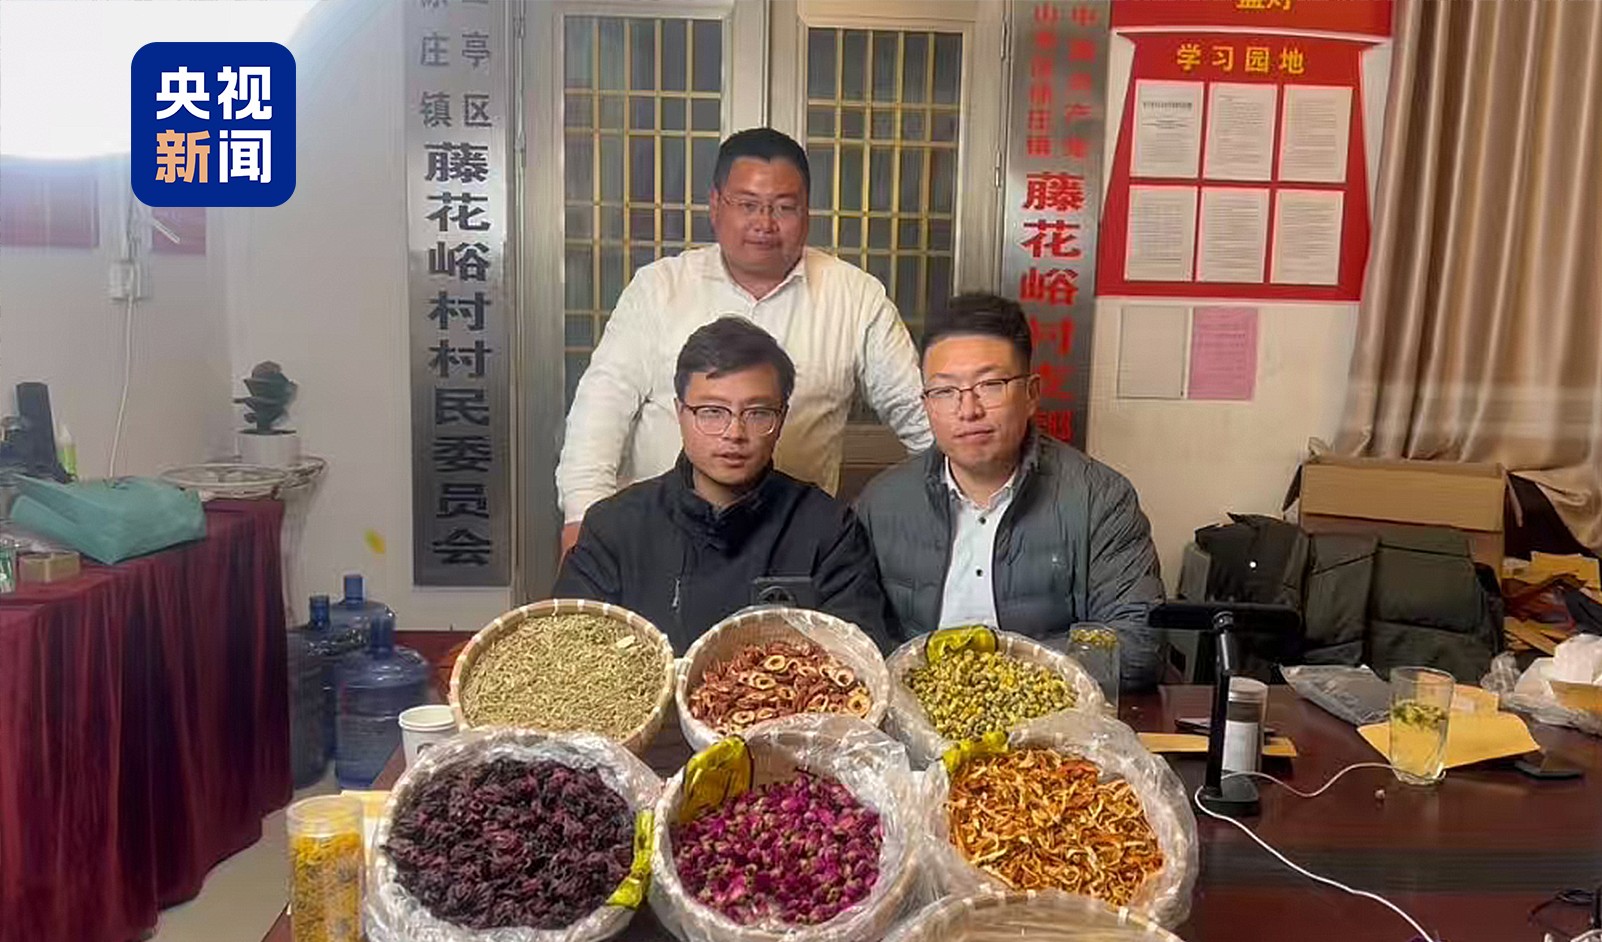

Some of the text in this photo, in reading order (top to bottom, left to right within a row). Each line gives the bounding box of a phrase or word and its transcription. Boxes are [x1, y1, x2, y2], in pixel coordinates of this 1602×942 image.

[419, 0, 452, 127] 庄镇
[461, 0, 493, 127] 亭区
[1176, 43, 1305, 74] 学习园地
[424, 141, 493, 566] 藤花峪村村民委员会
